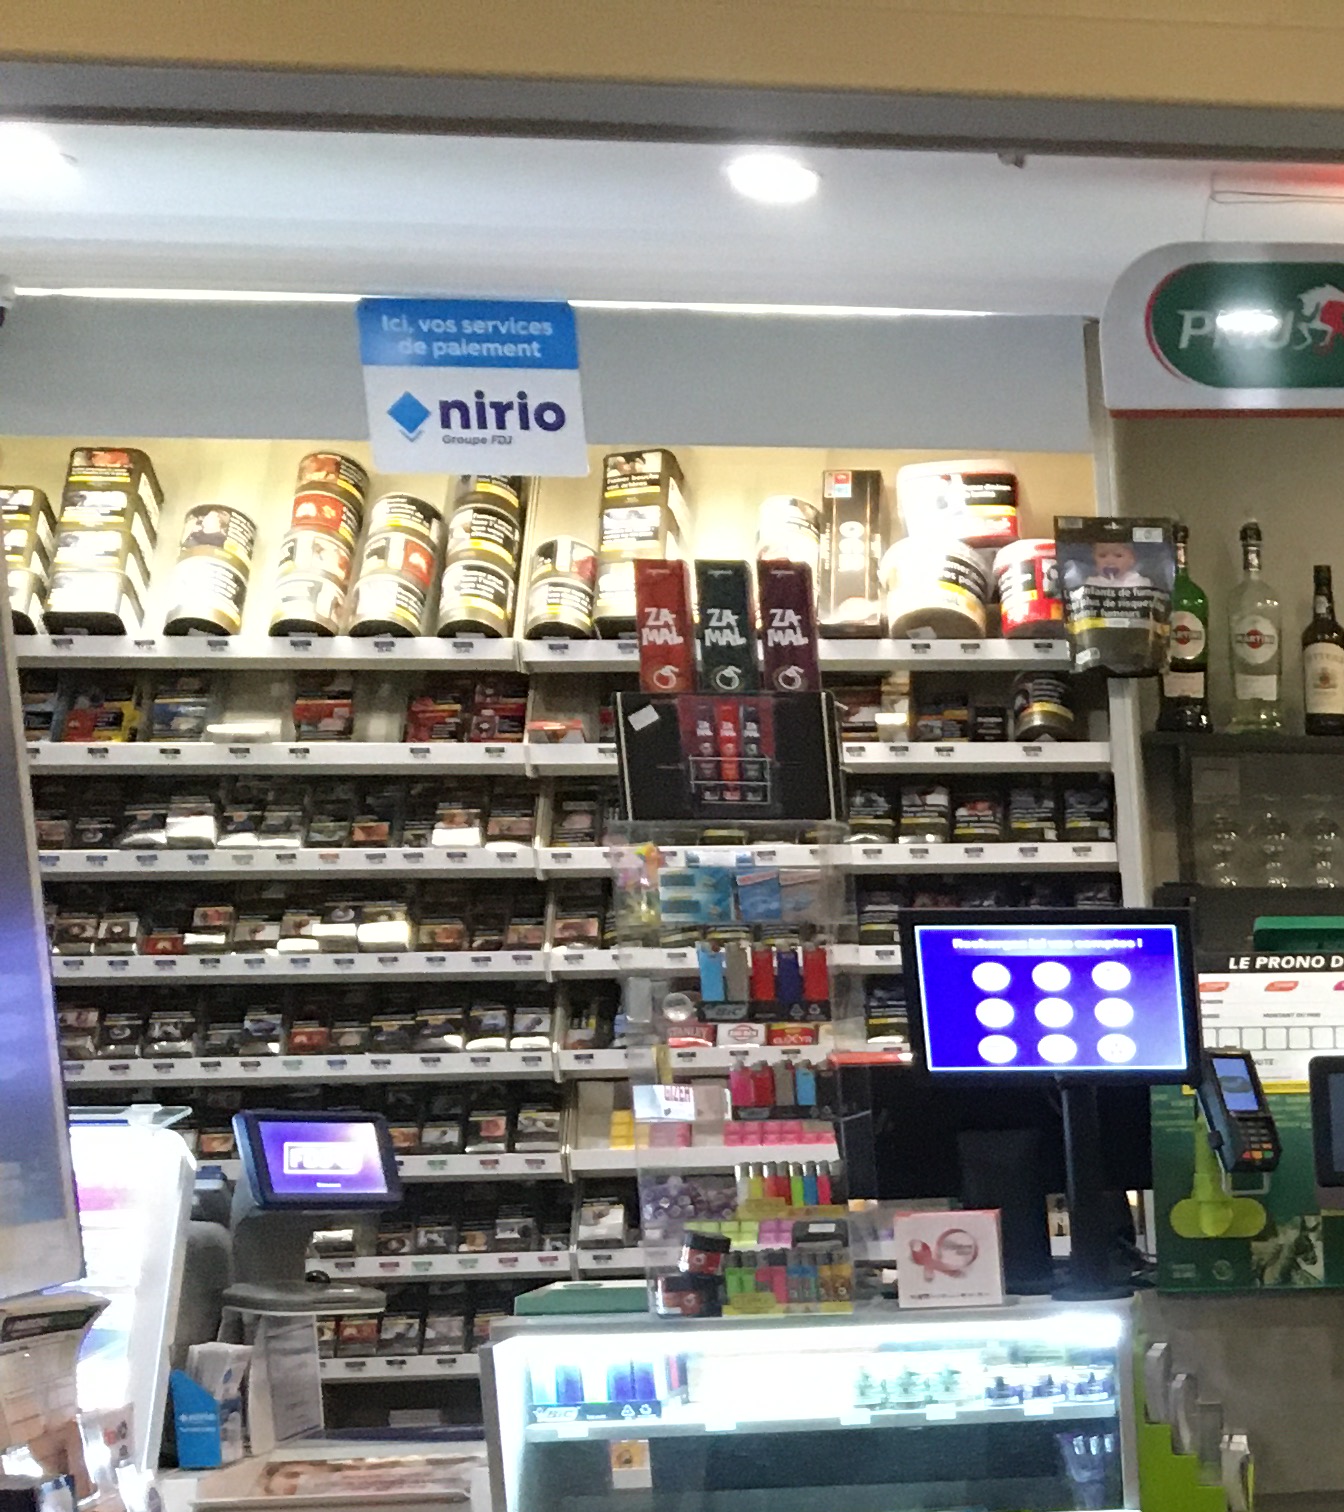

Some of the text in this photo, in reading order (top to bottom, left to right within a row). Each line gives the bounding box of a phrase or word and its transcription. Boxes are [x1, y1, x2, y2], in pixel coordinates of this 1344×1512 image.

[381, 314, 553, 336] Ici, vos services
[400, 338, 542, 358] de paiement
[438, 389, 566, 432] nirio
[442, 434, 513, 446] Groupe FDJ
[641, 627, 684, 647] MAL
[704, 627, 746, 647] MAL
[767, 627, 809, 647] MAL
[1228, 956, 1250, 970] LE
[1255, 956, 1325, 970] PRONO
